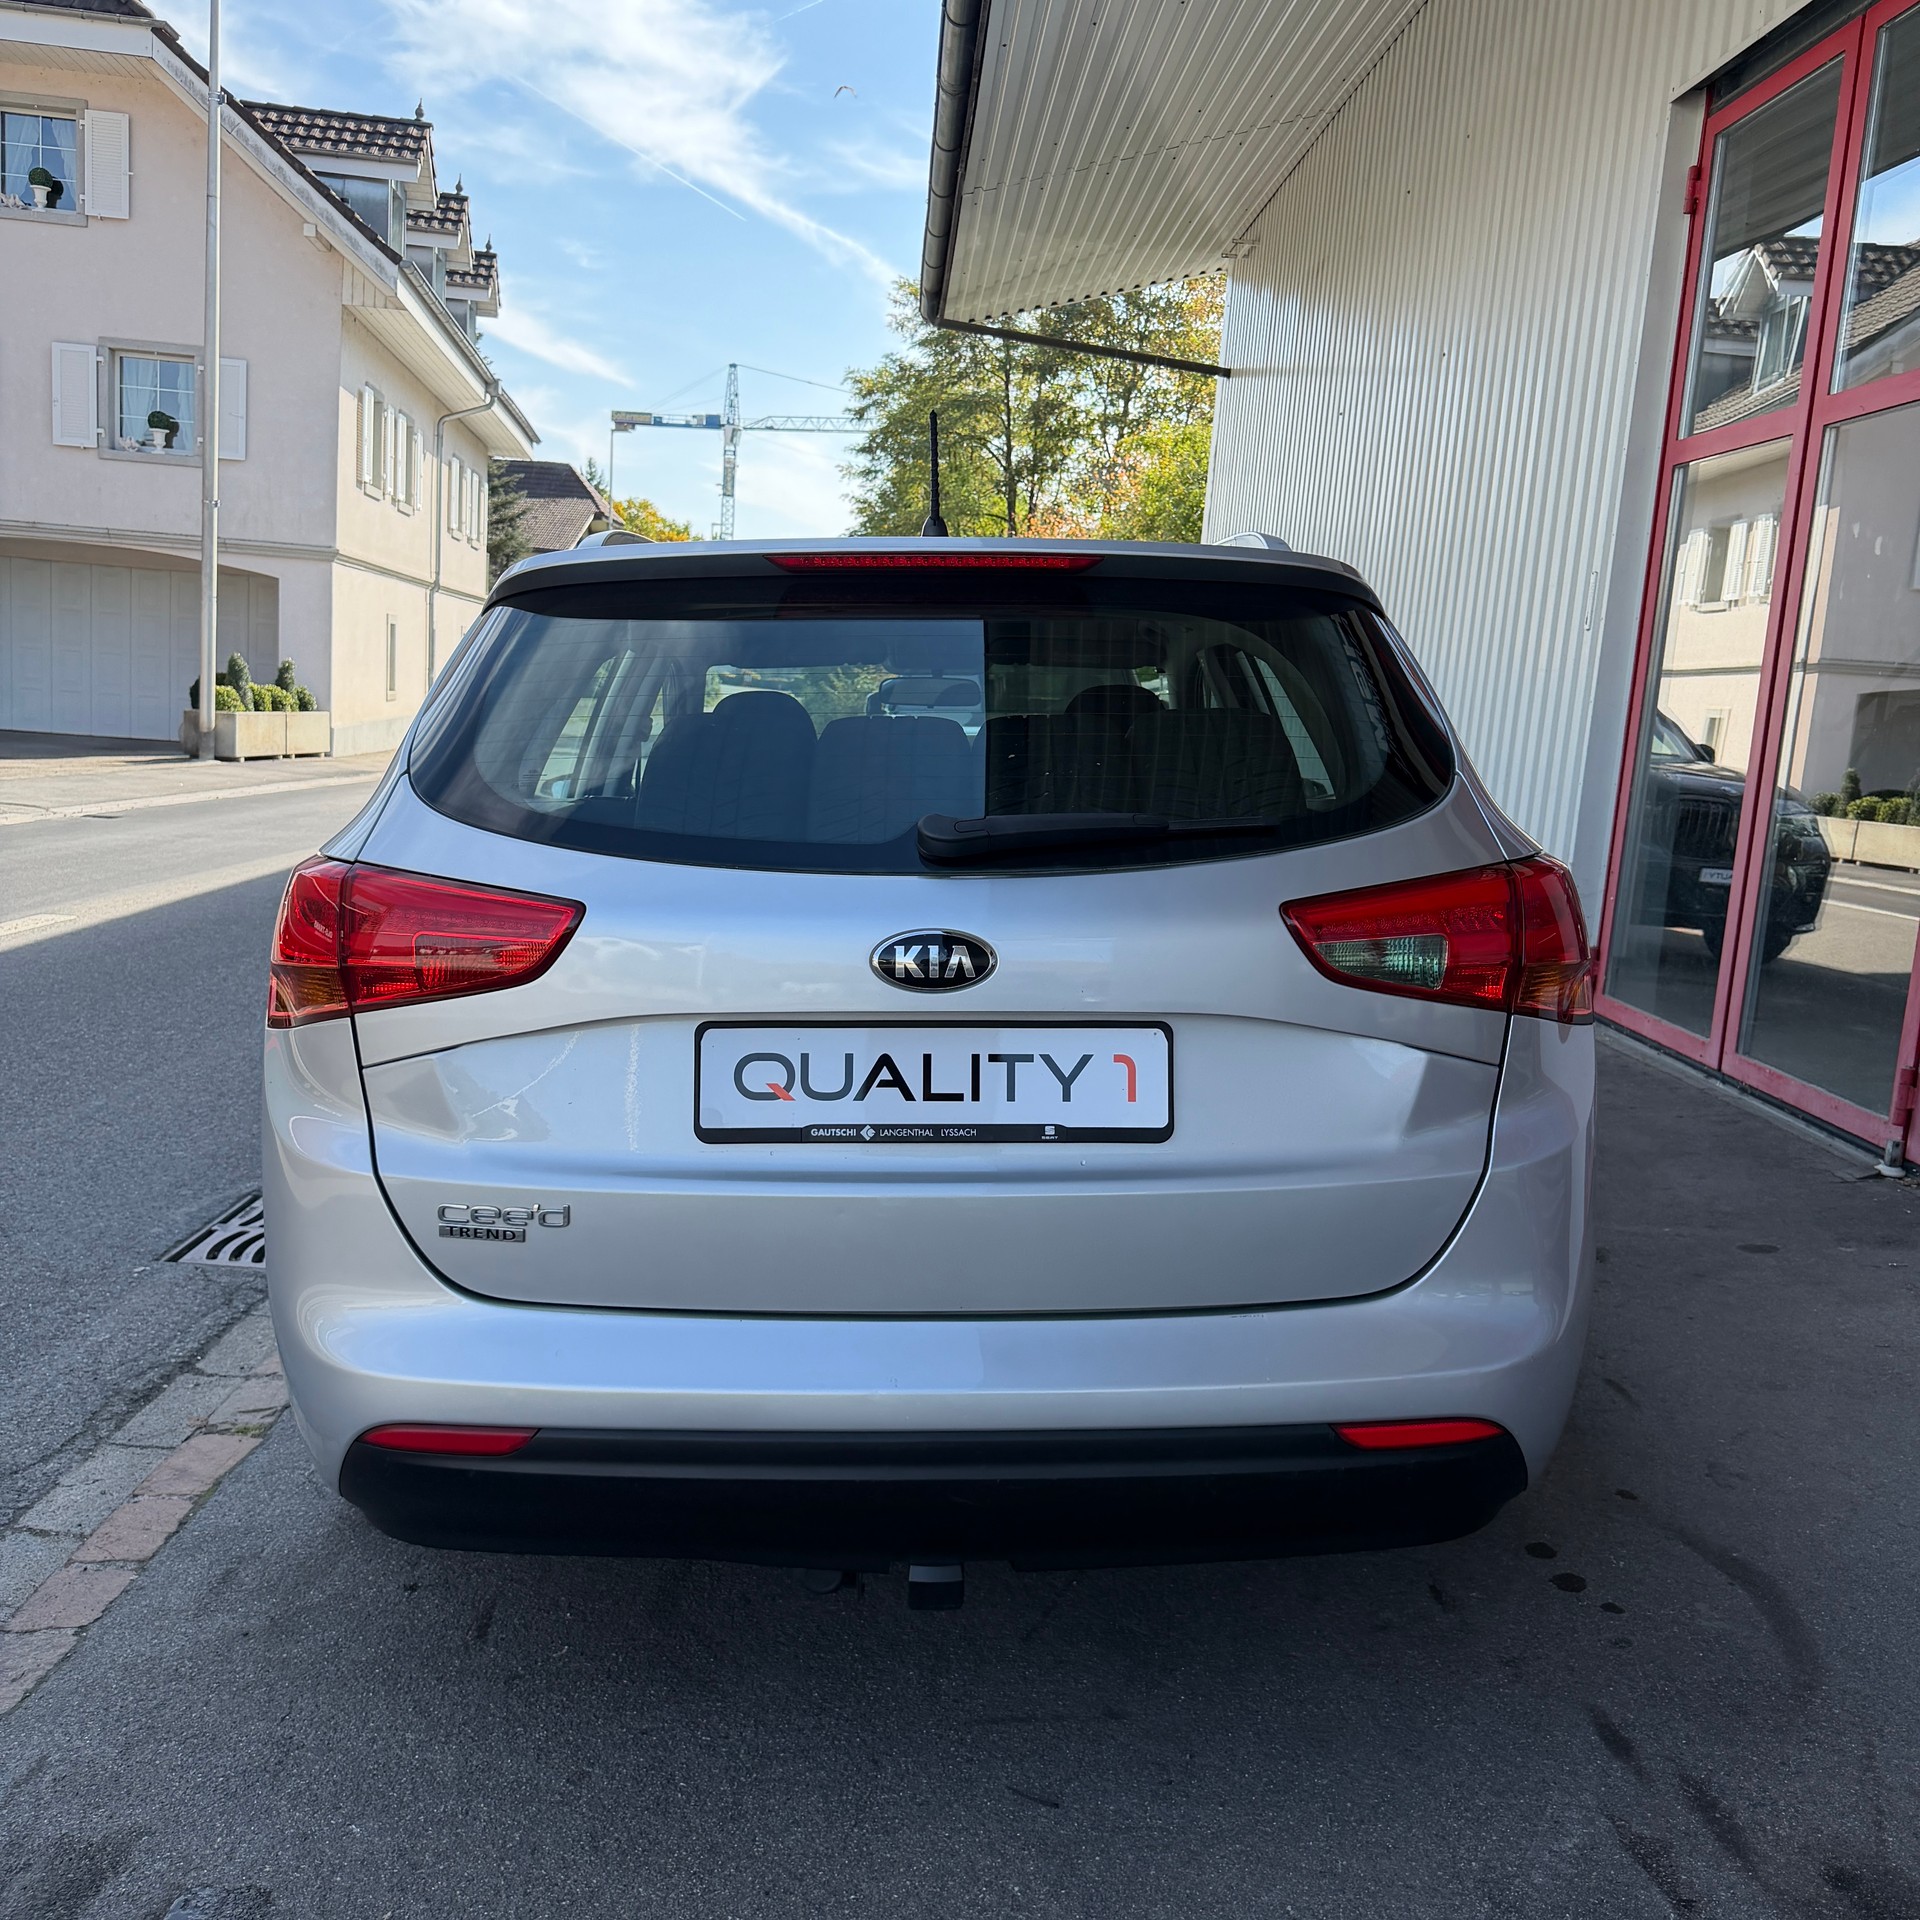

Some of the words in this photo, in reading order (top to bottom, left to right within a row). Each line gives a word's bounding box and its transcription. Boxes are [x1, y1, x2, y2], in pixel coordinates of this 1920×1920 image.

[893, 945, 976, 978] KIA
[733, 1052, 1094, 1102] QUALITY
[1113, 1053, 1137, 1103] 1
[810, 1128, 857, 1137] GAUTSCHI
[879, 1128, 934, 1137] LANGENTHAL
[940, 1128, 977, 1137] LYSSACH
[445, 1226, 517, 1241] TREND
